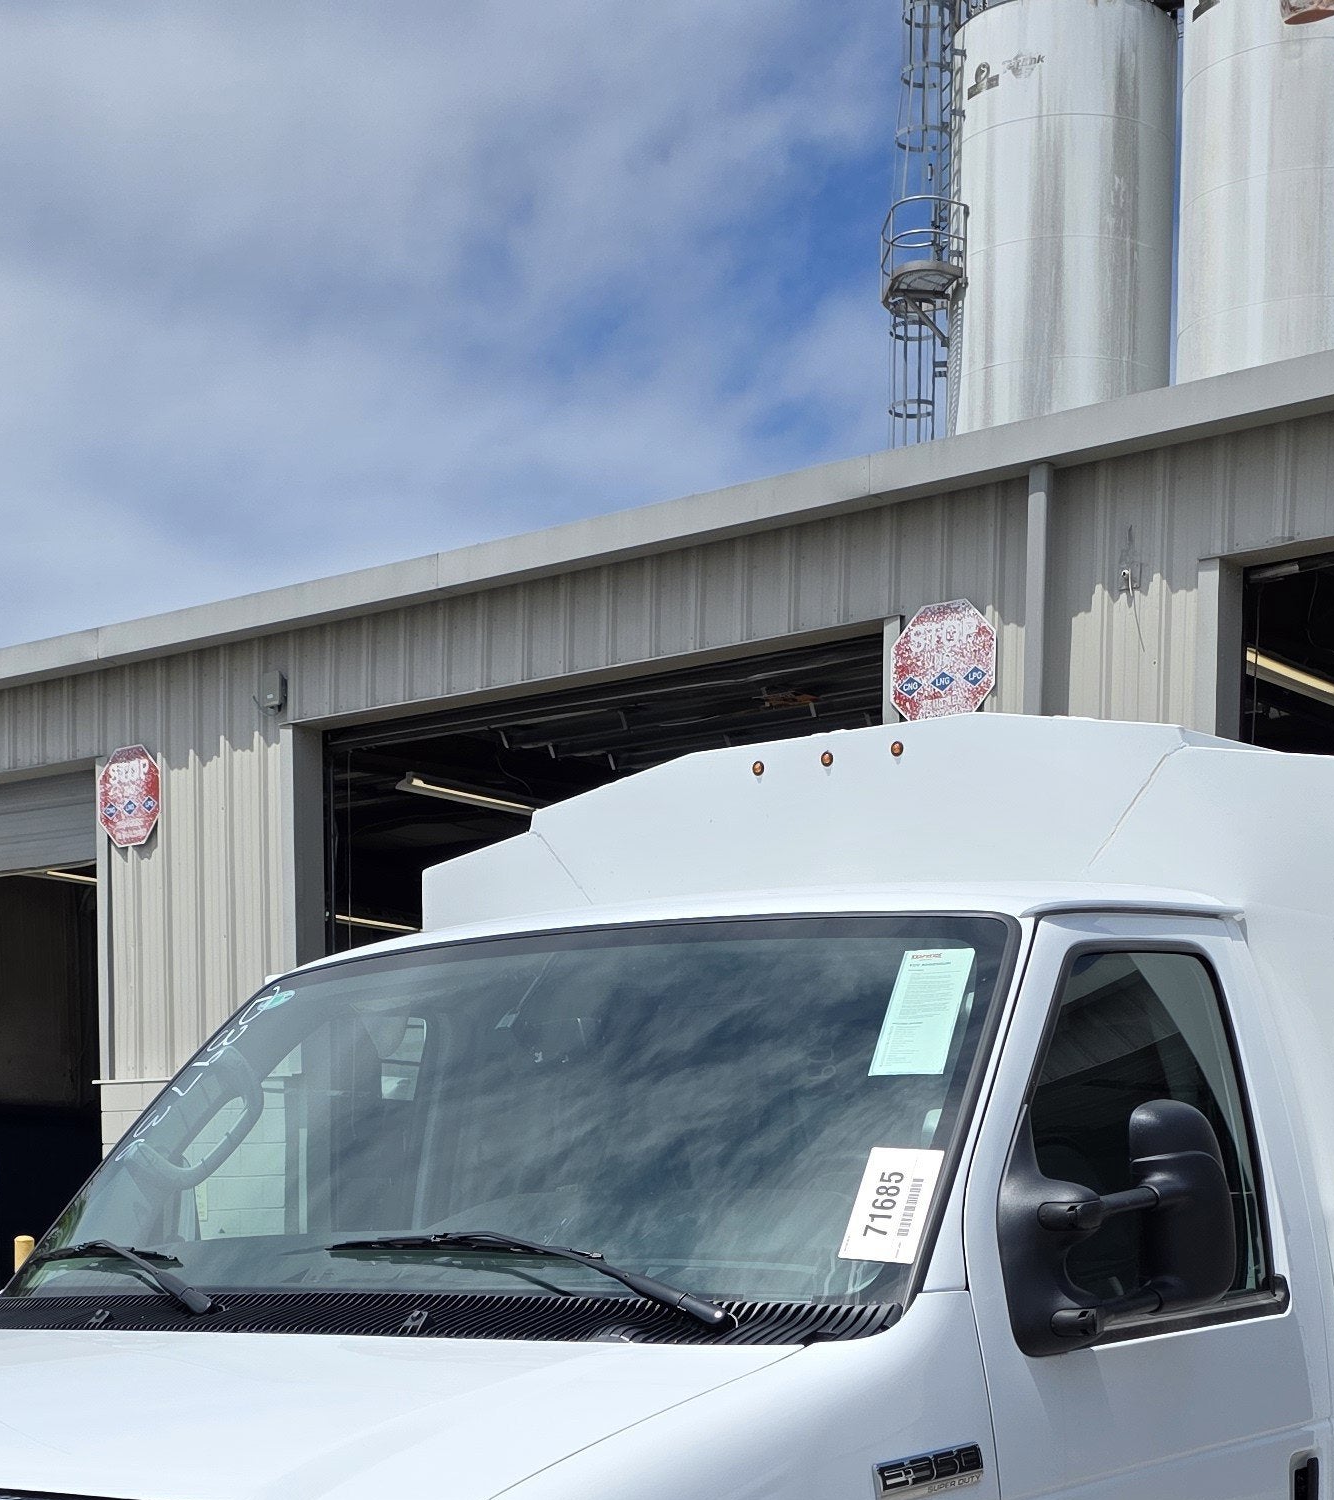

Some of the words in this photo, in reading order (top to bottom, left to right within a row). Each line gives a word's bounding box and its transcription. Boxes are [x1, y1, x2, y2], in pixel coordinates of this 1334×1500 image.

[909, 617, 978, 653] STOP
[902, 681, 919, 692] CNG
[935, 676, 951, 687] LNG
[968, 671, 983, 681] LPG
[109, 758, 149, 784] STOP
[862, 1171, 905, 1237] 71685
[927, 1480, 956, 1494] SUPER
[957, 1473, 982, 1487] DUTY
